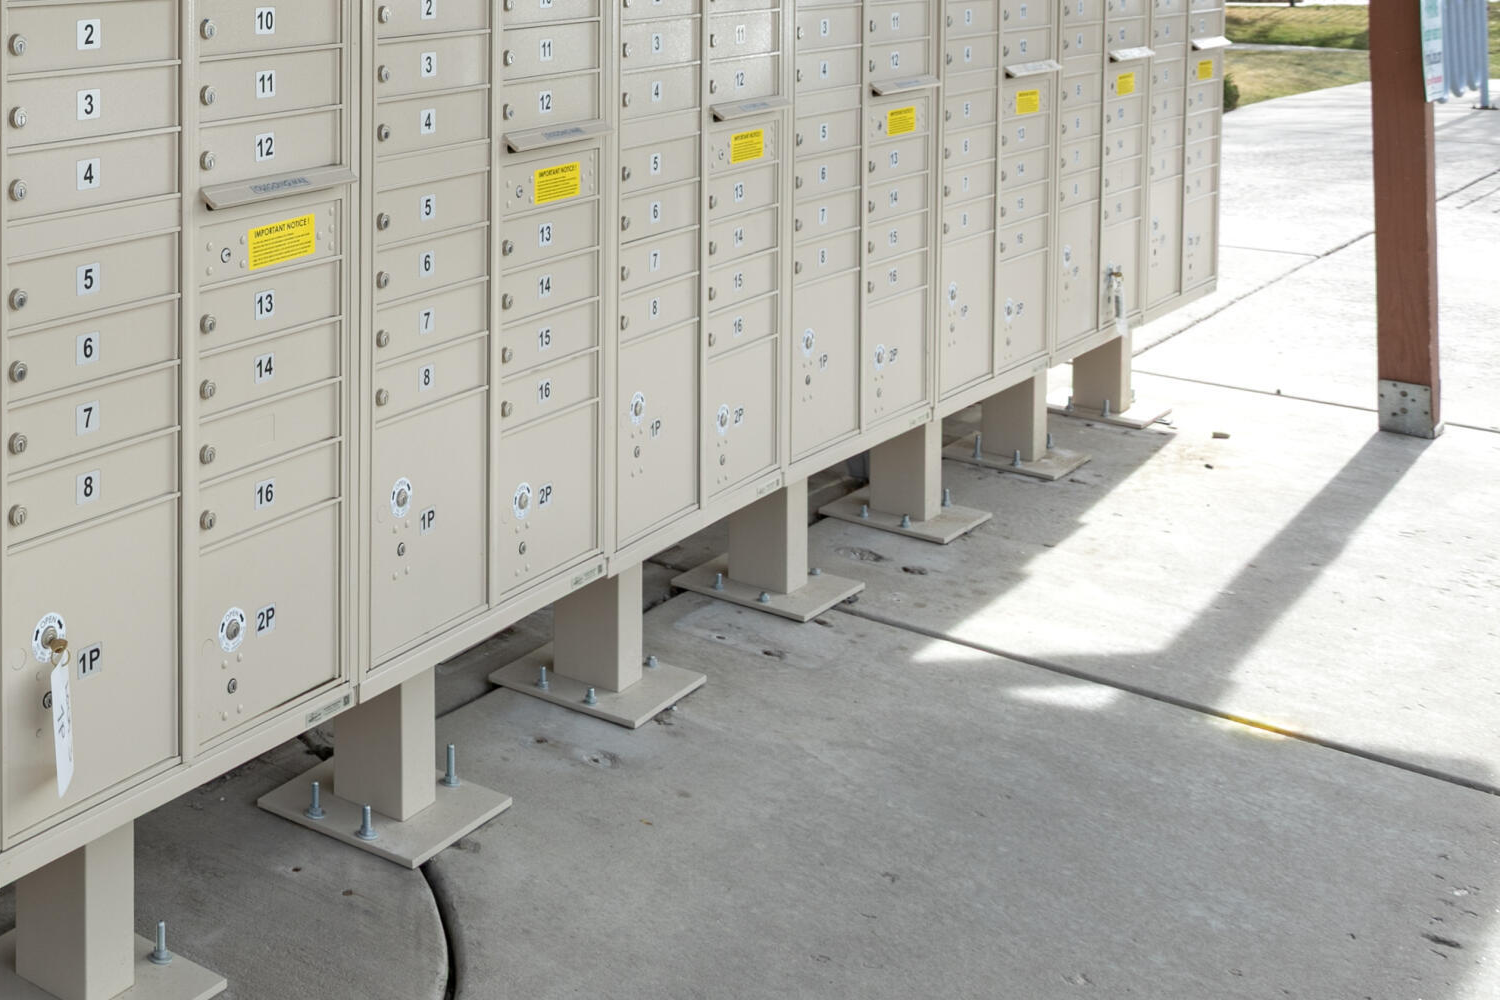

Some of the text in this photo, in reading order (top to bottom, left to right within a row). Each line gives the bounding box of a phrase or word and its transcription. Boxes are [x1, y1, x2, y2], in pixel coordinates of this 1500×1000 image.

[257, 11, 274, 30] 10
[84, 23, 94, 45] 2
[654, 35, 660, 51] 3
[737, 28, 744, 42] 11
[541, 41, 551, 57] 11
[425, 55, 433, 74] 3
[259, 73, 273, 93] 11
[736, 72, 744, 87] 12
[654, 84, 660, 98] 4
[84, 94, 94, 115] 3
[539, 94, 551, 110] 12
[424, 112, 432, 130] 4
[257, 137, 274, 158] 12
[653, 156, 659, 171] 5
[83, 163, 94, 184] 4
[734, 184, 744, 198] 13
[424, 198, 432, 216] 5
[652, 204, 659, 219] 6
[254, 223, 286, 238] IMPORTANT
[286, 219, 307, 230] NOTICE
[539, 225, 551, 242] 13
[734, 229, 744, 243] 14
[424, 254, 431, 272] 6
[652, 252, 658, 268] 7
[83, 268, 94, 290] 5
[539, 277, 551, 294] 14
[734, 273, 743, 289] 15
[257, 293, 273, 315] 13
[652, 300, 658, 315] 8
[423, 311, 431, 329] 7
[733, 318, 742, 333] 16
[539, 329, 551, 347] 15
[83, 337, 93, 359] 6
[256, 356, 273, 378] 14
[423, 368, 431, 386] 8
[539, 381, 551, 399] 16
[83, 406, 93, 429] 7
[734, 407, 744, 424] 2P
[650, 419, 662, 437] 1P
[83, 476, 93, 498] 8
[257, 483, 274, 505] 16
[539, 485, 552, 505] 2P
[420, 509, 435, 530] 1P
[40, 615, 57, 629] OPEN
[257, 607, 275, 632] 2P
[79, 647, 101, 674] 1P
